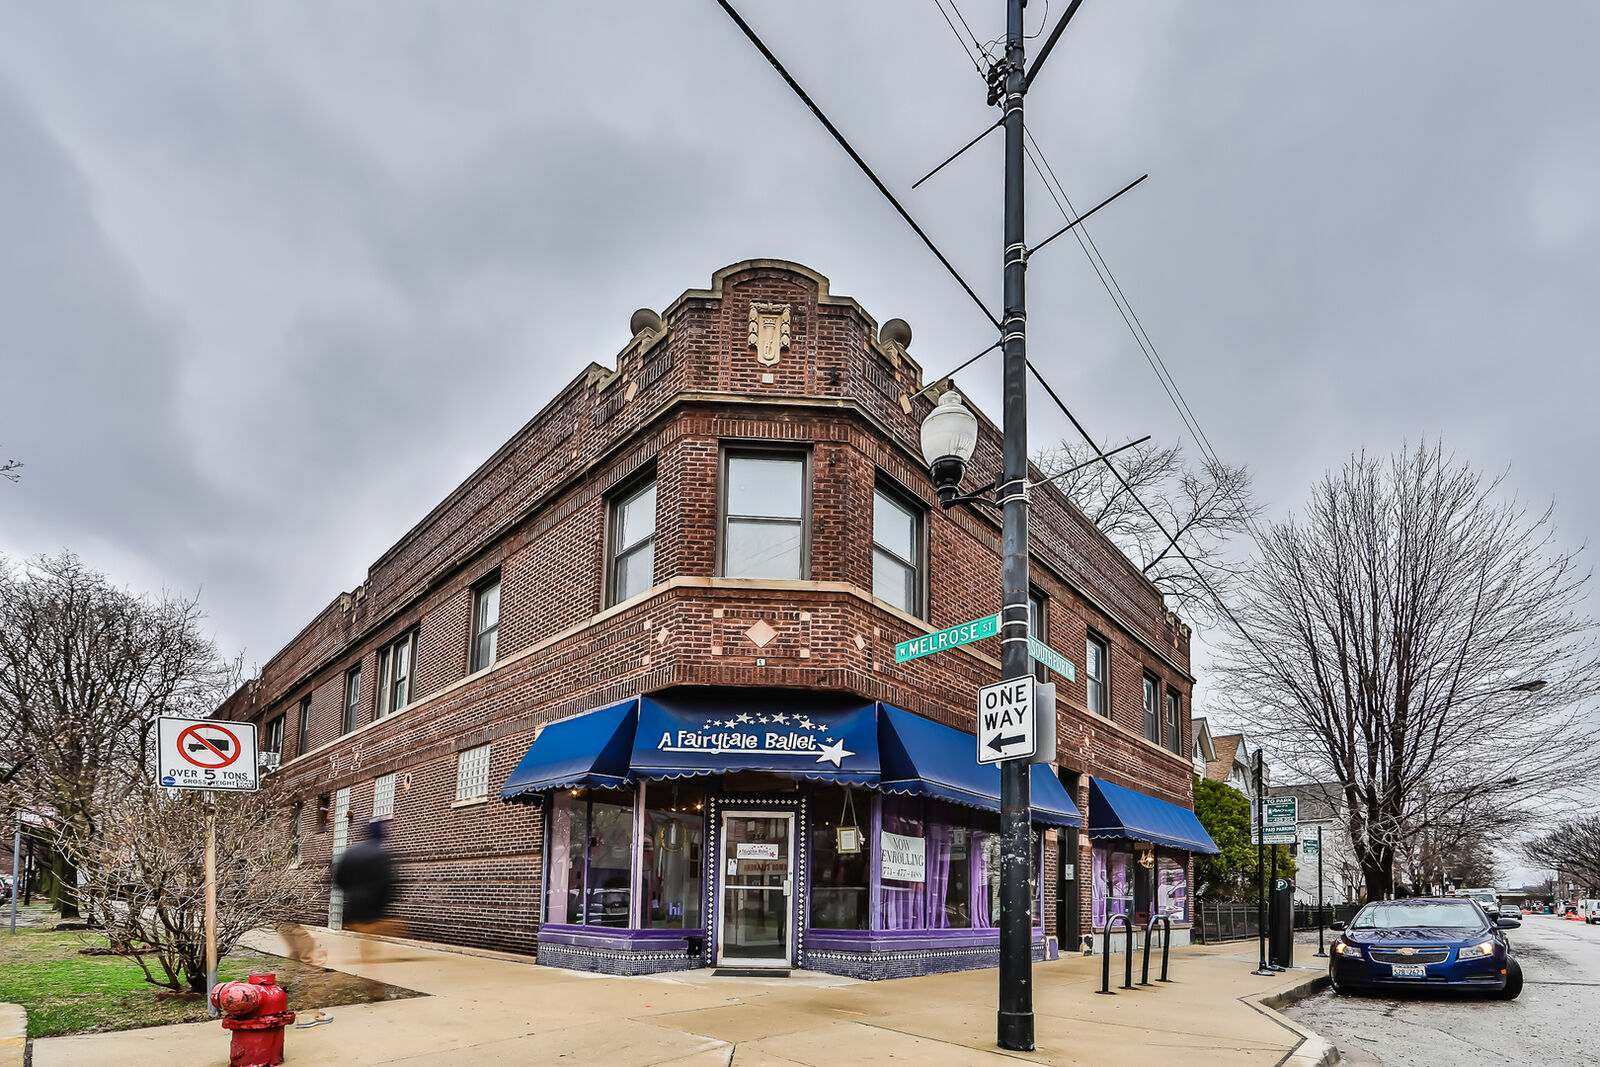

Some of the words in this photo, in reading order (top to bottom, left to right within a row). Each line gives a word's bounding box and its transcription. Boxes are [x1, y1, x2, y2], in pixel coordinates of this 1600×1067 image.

[899, 647, 906, 656] W
[908, 623, 979, 657] MELROSE
[982, 622, 993, 632] ST
[1030, 639, 1069, 676] SOUTHPORT
[985, 683, 1027, 709] ONE
[984, 705, 1028, 731] WAY
[657, 732, 672, 749] A
[677, 730, 758, 754] Fairytale
[765, 732, 818, 750] Ballet
[169, 768, 198, 778] OVER
[204, 769, 216, 780] 5
[222, 771, 248, 780] TONS
[892, 837, 911, 850] NOW
[881, 849, 924, 866] ENROLLING
